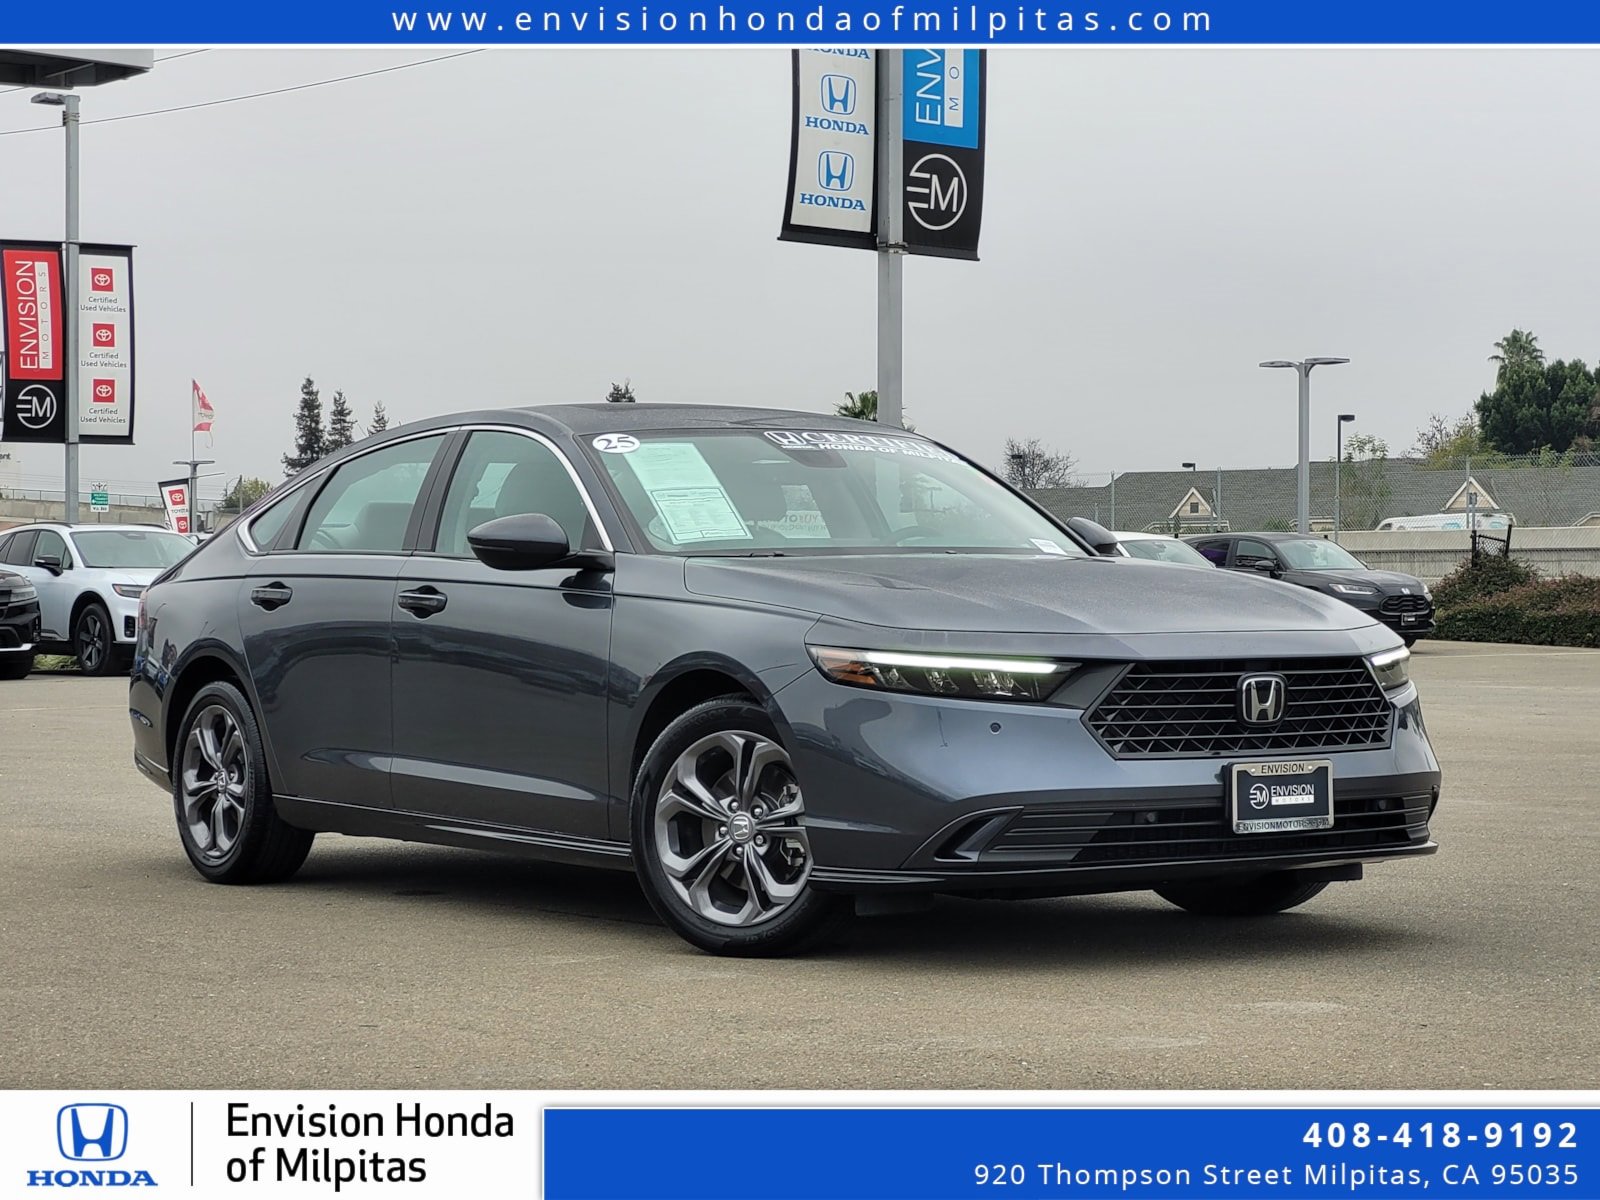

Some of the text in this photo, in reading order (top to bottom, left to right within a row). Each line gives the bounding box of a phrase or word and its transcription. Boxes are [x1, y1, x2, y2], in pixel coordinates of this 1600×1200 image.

[804, 116, 870, 136] HONDA
[799, 192, 866, 212] HONDA
[88, 296, 119, 304] Certified
[80, 304, 127, 313] Used Vehicles
[15, 260, 39, 370] ENVISION
[38, 271, 50, 360] MOTORS
[89, 352, 120, 360] Certified
[80, 360, 128, 369] Used Vehicles
[88, 407, 119, 416] Certified
[80, 416, 127, 424] Used Vehicles
[597, 436, 636, 450] 25
[819, 443, 877, 452] HONDA
[878, 446, 898, 454] OF
[1261, 763, 1305, 774] ENVISION
[1270, 784, 1315, 797] ENVISION
